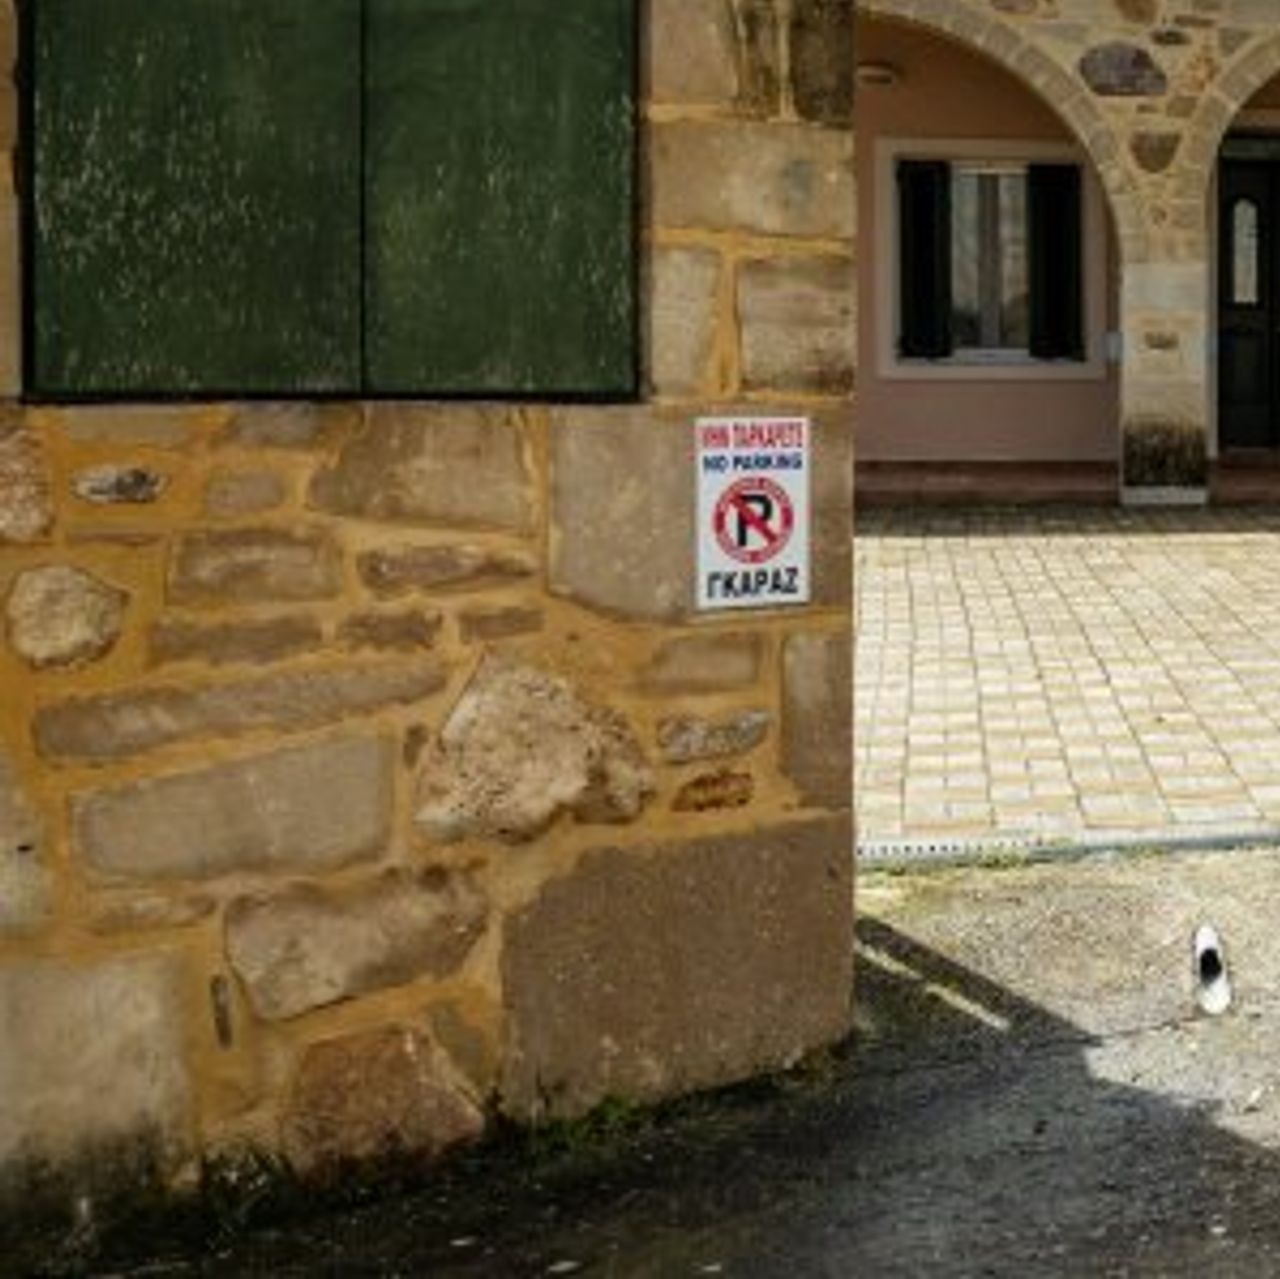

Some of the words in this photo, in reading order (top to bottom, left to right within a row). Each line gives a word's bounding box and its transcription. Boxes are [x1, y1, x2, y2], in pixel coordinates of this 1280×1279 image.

[703, 454, 729, 471] NO
[733, 453, 803, 470] PARKING
[706, 567, 799, 599] ΓΚΑΡΑΖ
